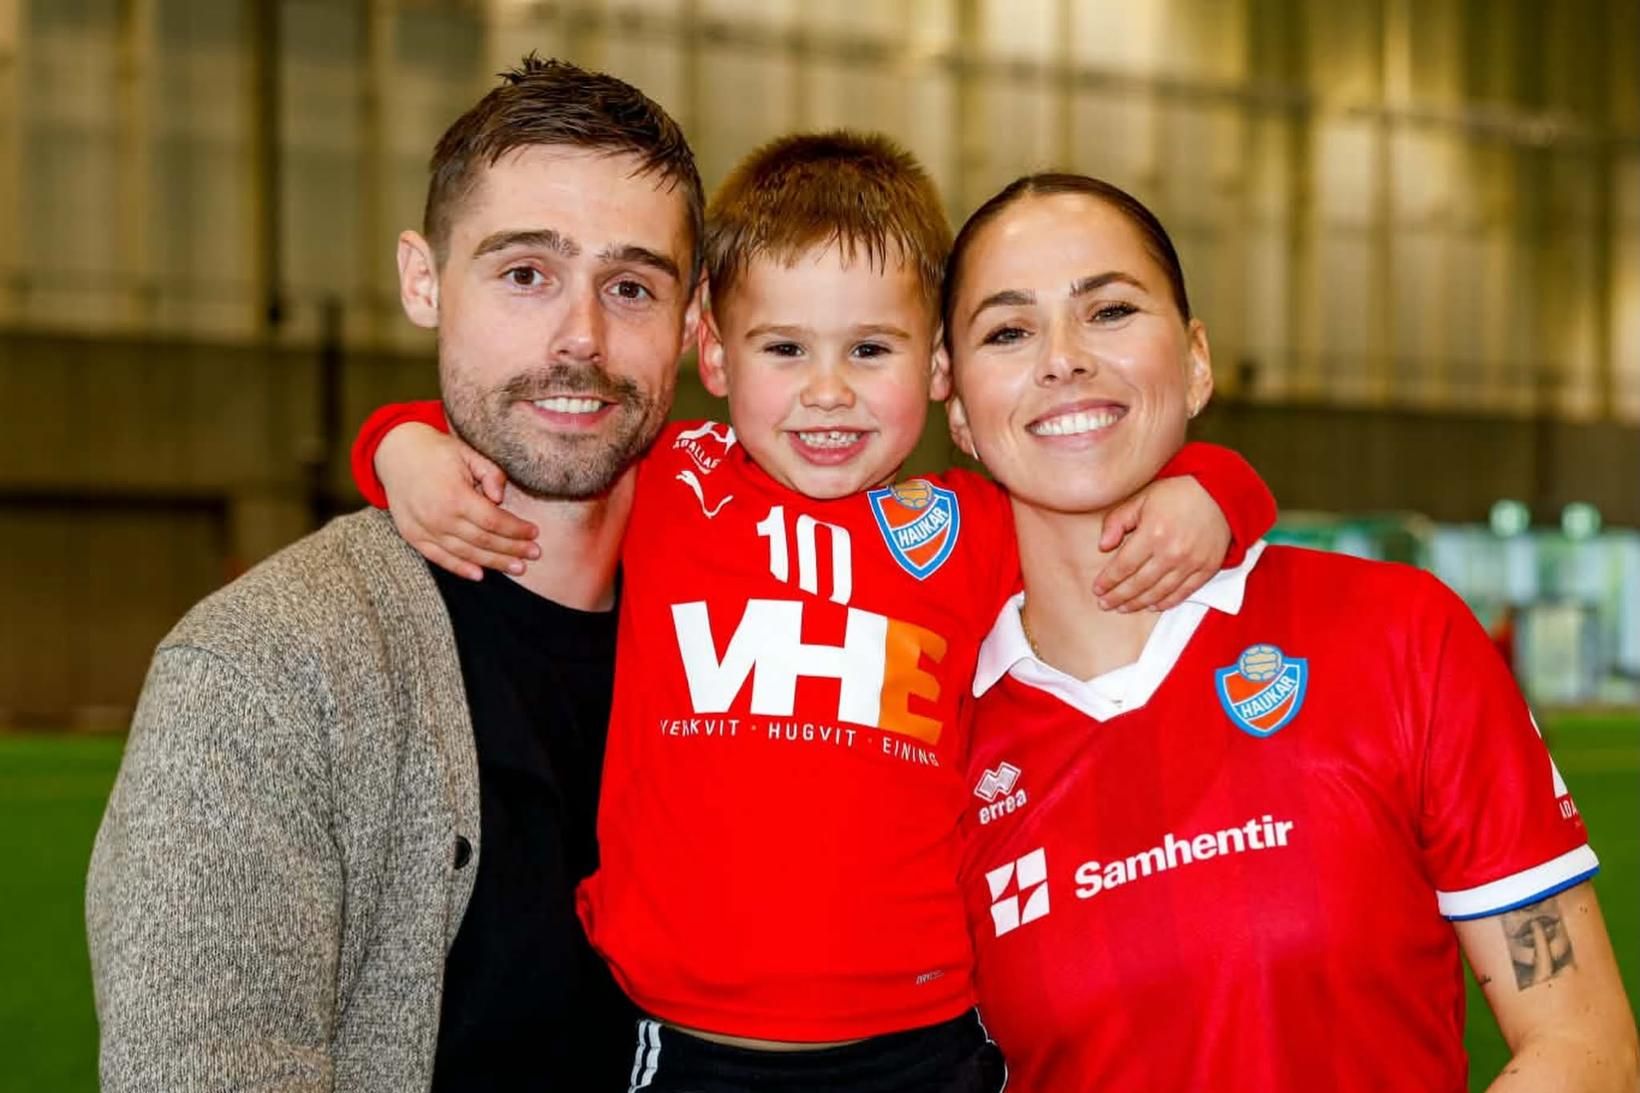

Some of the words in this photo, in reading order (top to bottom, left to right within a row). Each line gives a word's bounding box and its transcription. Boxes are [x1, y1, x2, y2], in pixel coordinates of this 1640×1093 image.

[756, 505, 852, 606] 10
[898, 507, 948, 547] HAUKAR
[671, 597, 948, 747] VHE
[1241, 676, 1296, 718] HAUKAR
[768, 722, 856, 746] HUGVIT
[883, 736, 940, 767] EINING
[1074, 814, 1294, 899] Samhentir
